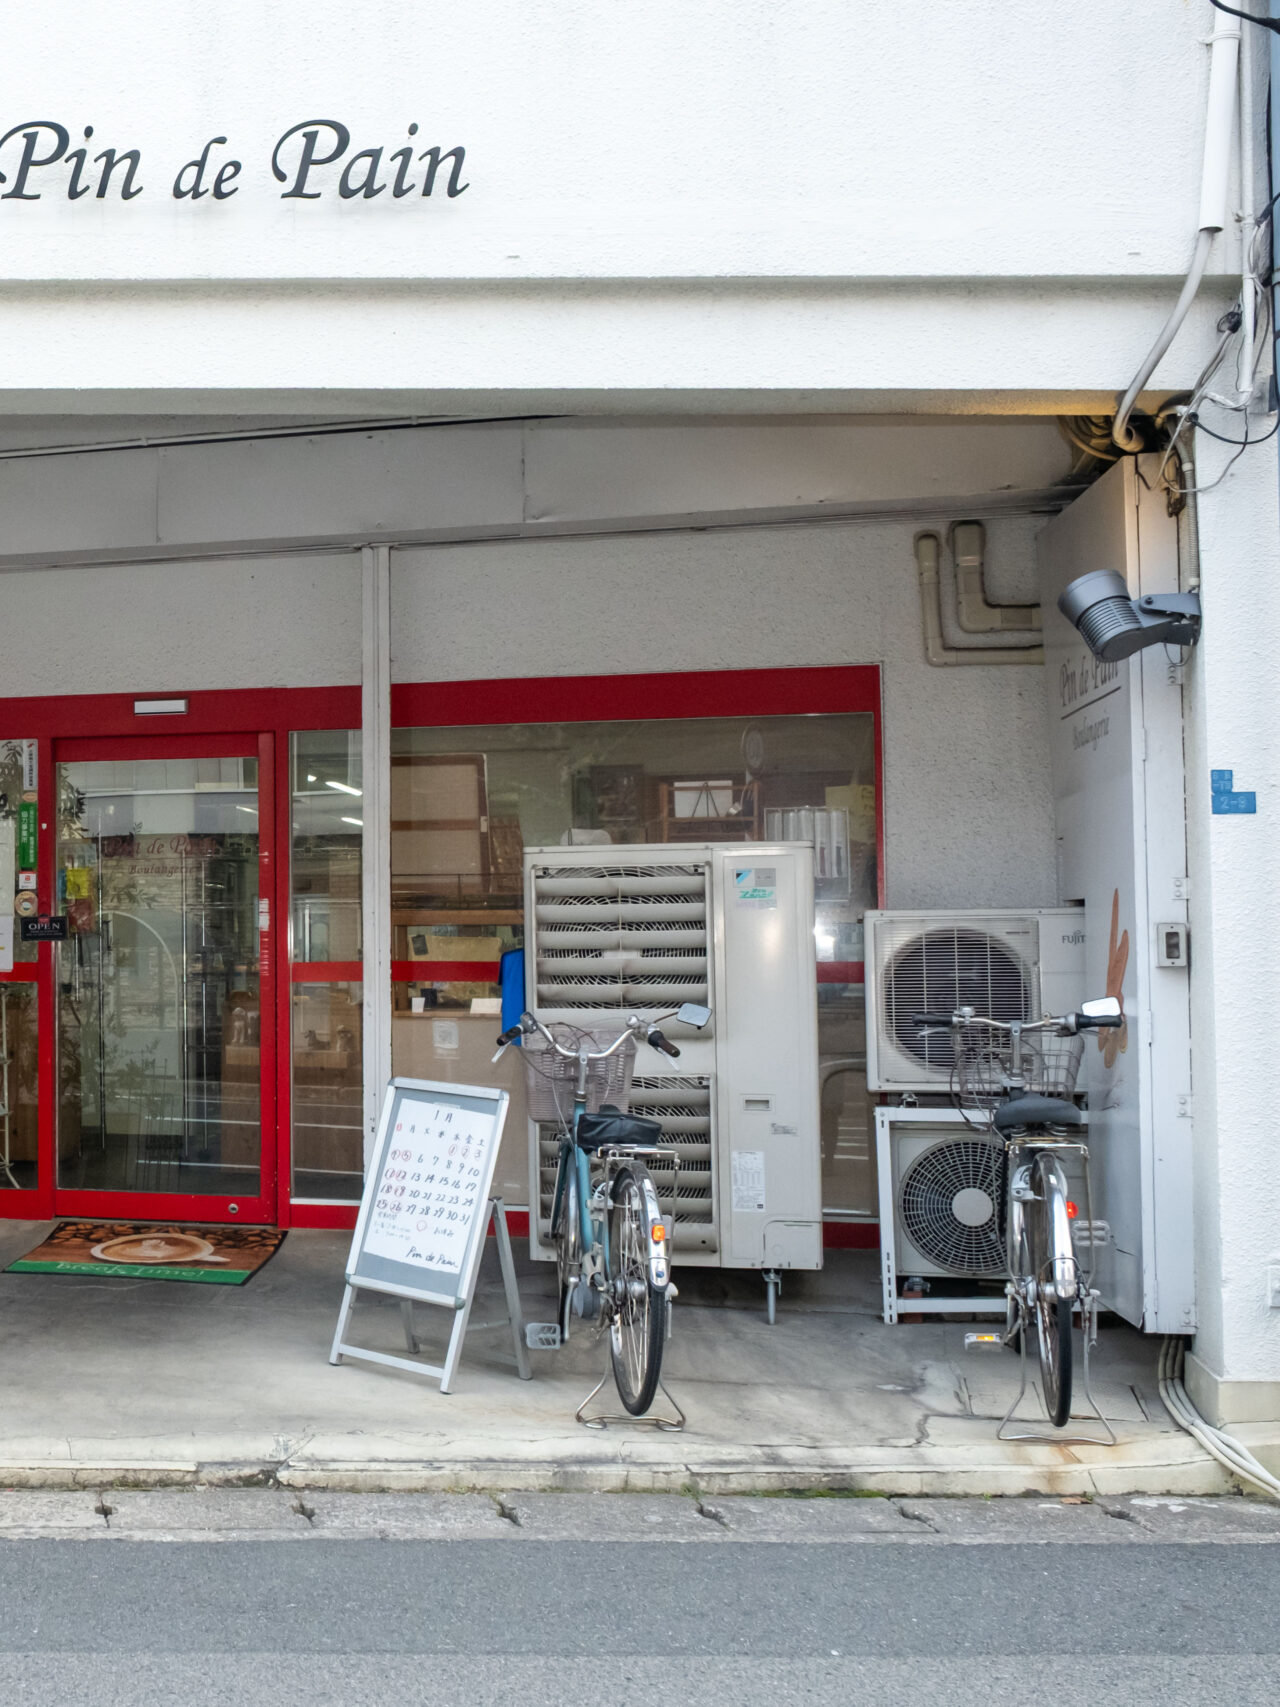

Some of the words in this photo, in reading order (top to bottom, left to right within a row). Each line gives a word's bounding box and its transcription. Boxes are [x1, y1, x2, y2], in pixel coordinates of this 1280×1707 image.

[172, 136, 242, 200] de
[271, 119, 470, 200] Pain
[1061, 658, 1077, 707] Pin
[1080, 655, 1088, 696] de
[146, 838, 165, 854] de
[28, 922, 60, 930] OPEN
[433, 1155, 439, 1166] 7
[458, 1162, 465, 1174] 9
[467, 1167, 480, 1177] 10
[411, 1172, 421, 1182] 13
[425, 1174, 435, 1183] 14
[439, 1176, 449, 1186] 15
[451, 1180, 461, 1189] 16
[465, 1182, 477, 1192] 17
[409, 1189, 421, 1198] 20
[422, 1192, 432, 1201] 21
[435, 1193, 446, 1202] 22
[448, 1195, 459, 1204] 23
[461, 1198, 474, 1207] 24
[406, 1203, 417, 1215] 27
[418, 1205, 431, 1216] 28
[433, 1206, 445, 1218] 29
[446, 1209, 458, 1221] 30
[459, 1214, 471, 1225] 31
[405, 1246, 422, 1258] Pin
